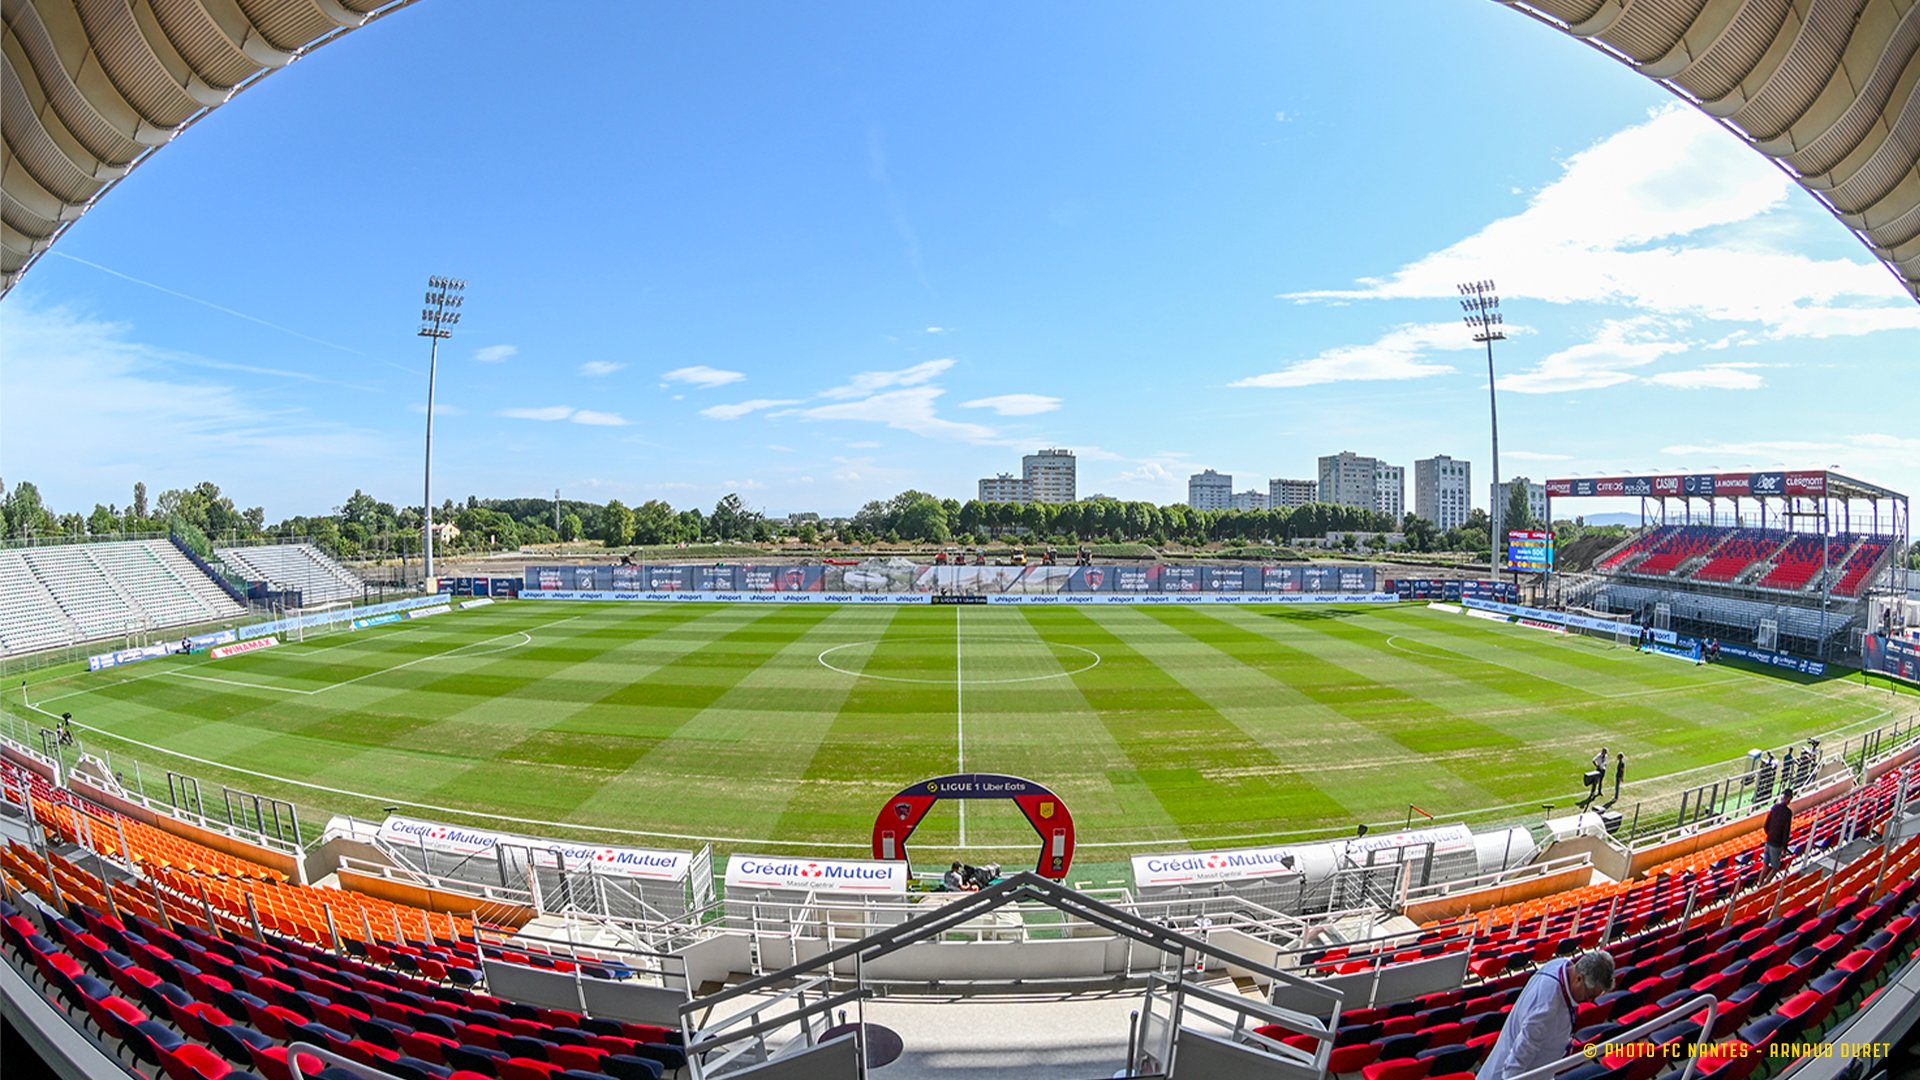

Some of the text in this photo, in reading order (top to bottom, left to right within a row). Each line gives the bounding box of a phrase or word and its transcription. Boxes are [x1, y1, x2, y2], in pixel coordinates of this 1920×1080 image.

[1656, 477, 1678, 489] CASINO
[221, 638, 272, 656] WINAMAX
[941, 783, 1026, 791] LIGUE 1 Uber Eats
[391, 820, 498, 847] Crédit Mutuel
[1345, 829, 1463, 855] Crédit Mutuel
[616, 852, 678, 868] Mutuel
[1148, 857, 1205, 873] Crédit
[741, 860, 893, 880] Crédit Mutuel
[1219, 870, 1243, 878] Central
[786, 880, 808, 888] Massif
